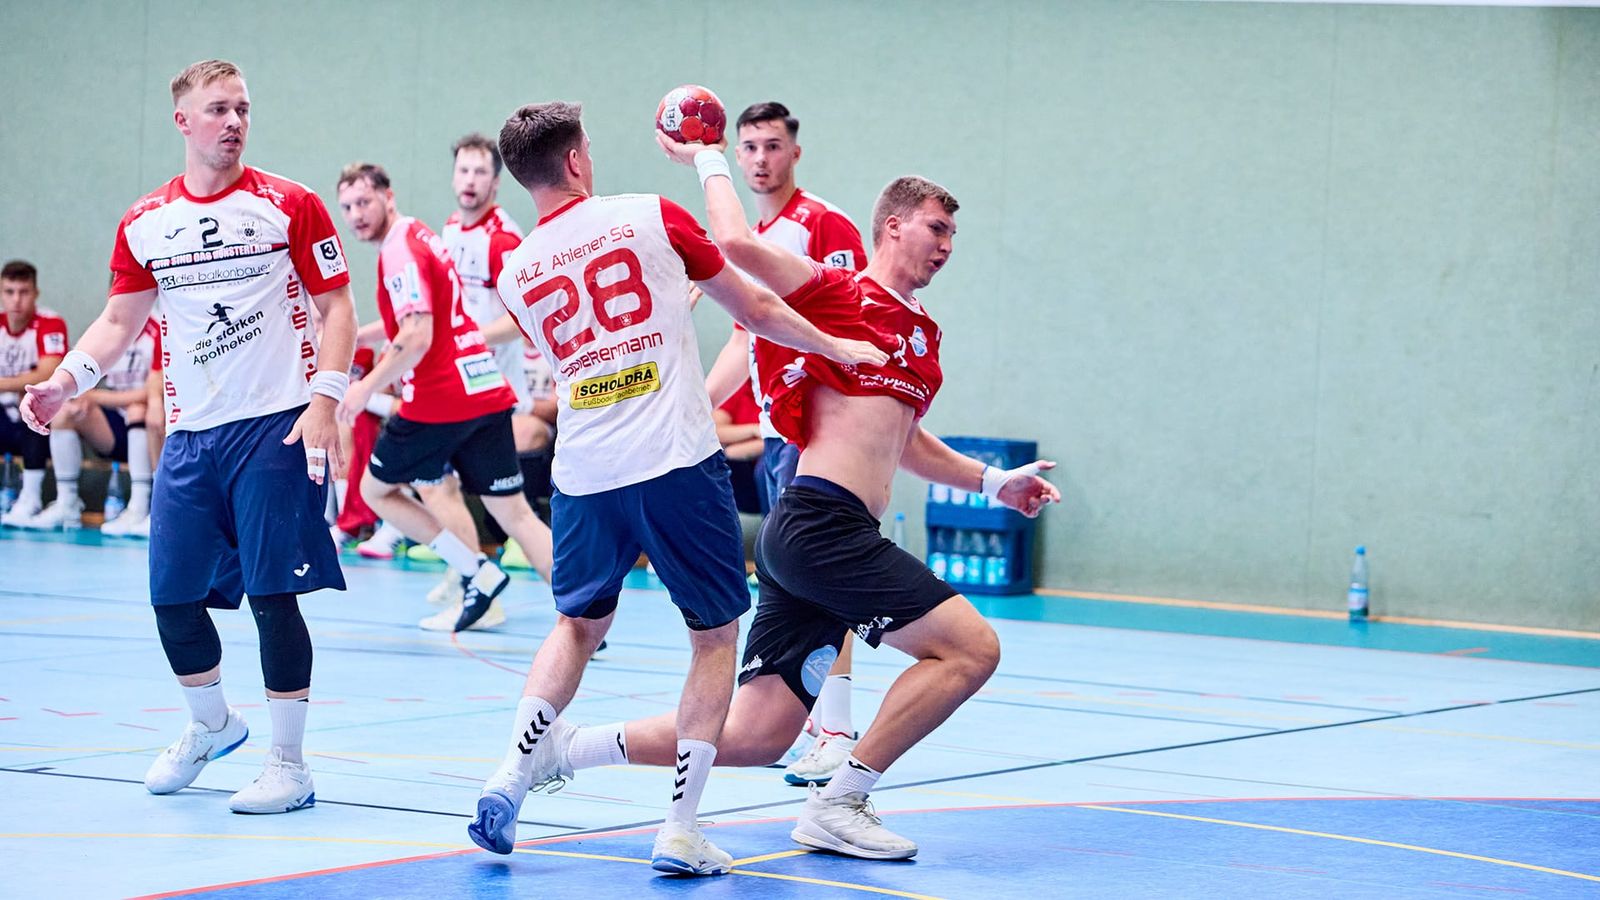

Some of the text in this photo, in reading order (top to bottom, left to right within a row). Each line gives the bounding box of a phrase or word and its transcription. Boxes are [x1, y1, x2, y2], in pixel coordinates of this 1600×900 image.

[199, 217, 224, 249] 2
[171, 253, 193, 267] SIND
[193, 251, 213, 264] DAS
[323, 243, 335, 258] 3
[515, 223, 635, 289] HLZ Ahlener SG
[175, 273, 195, 285] die
[522, 247, 653, 362] 28
[216, 311, 264, 343] starken
[193, 327, 263, 366] Apotheken
[580, 368, 654, 397] SCHOLDRA
